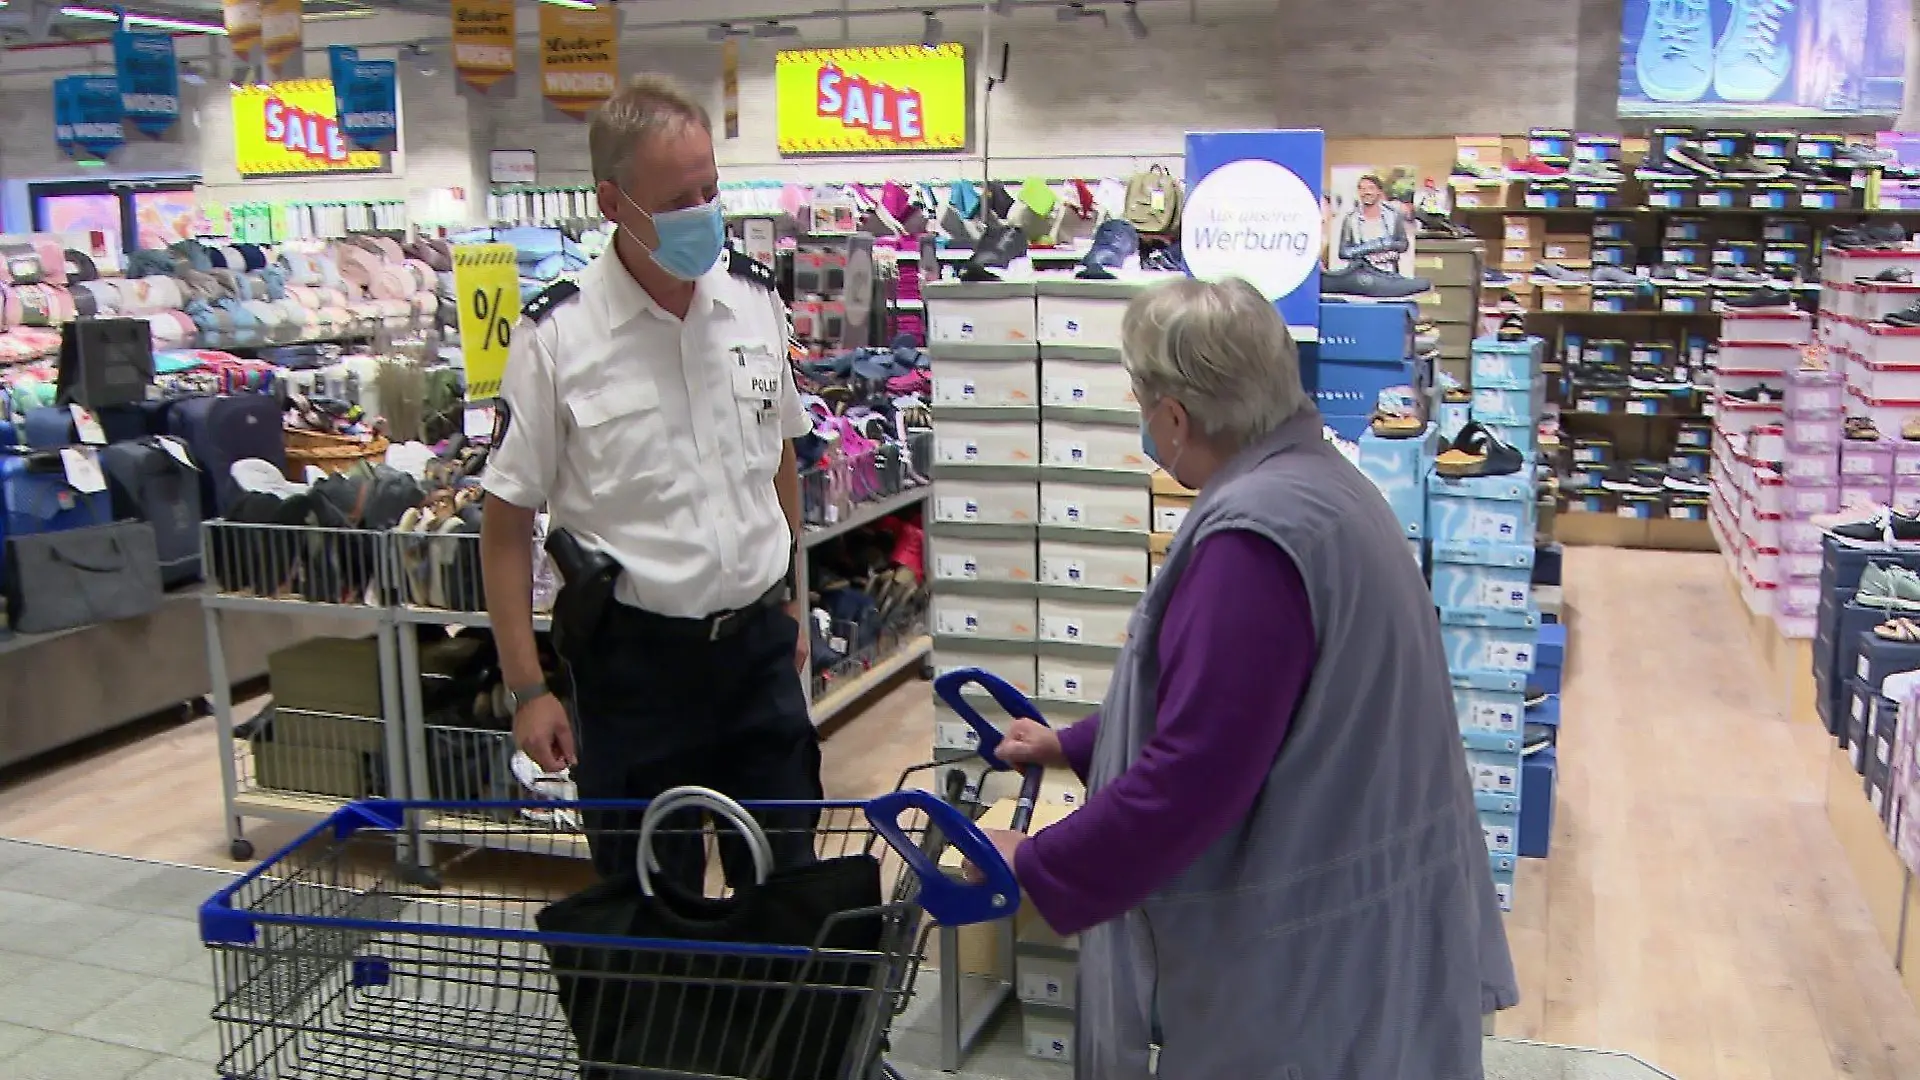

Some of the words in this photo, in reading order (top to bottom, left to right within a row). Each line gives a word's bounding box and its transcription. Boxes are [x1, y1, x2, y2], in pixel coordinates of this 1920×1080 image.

[545, 73, 615, 92] WOCHEN
[819, 69, 921, 138] SALE
[265, 102, 347, 160] SALE
[1194, 227, 1309, 256] Werbung
